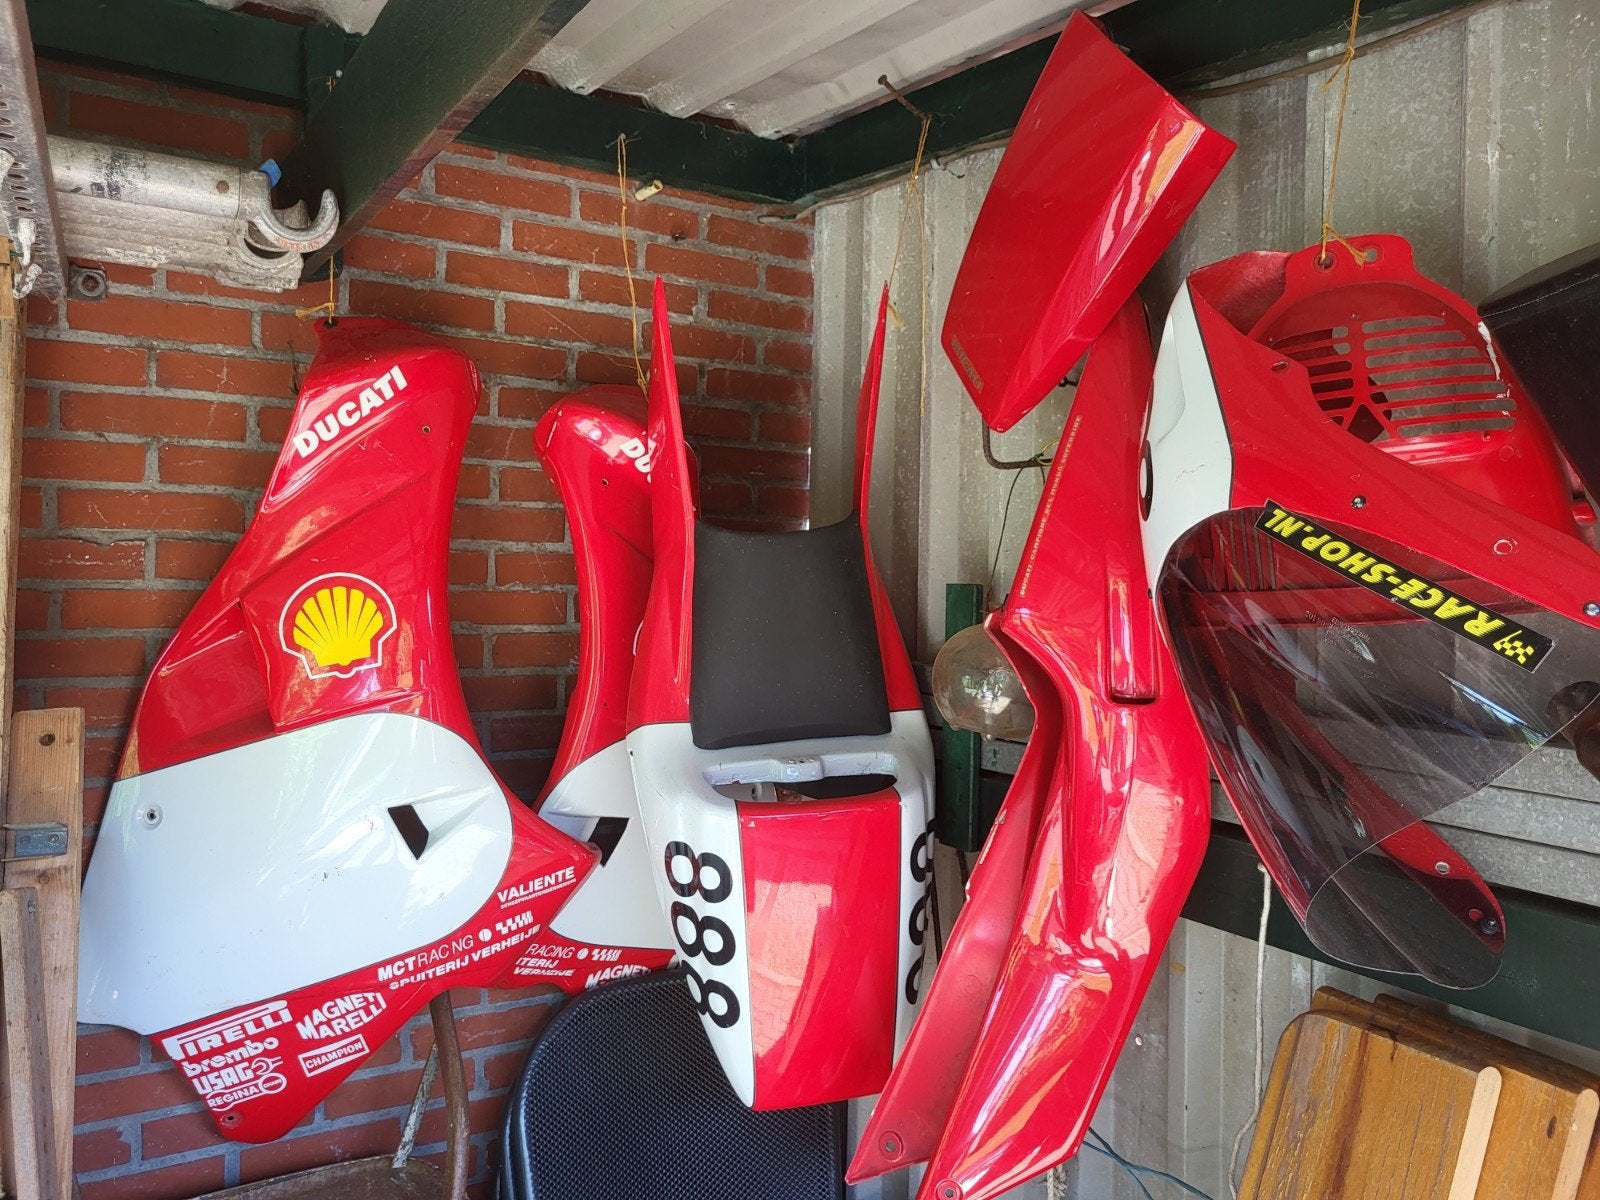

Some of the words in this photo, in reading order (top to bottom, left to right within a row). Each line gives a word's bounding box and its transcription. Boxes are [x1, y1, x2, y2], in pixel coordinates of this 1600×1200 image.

[292, 365, 408, 459] DUCATI
[620, 437, 652, 483] DU
[1020, 564, 1033, 597] DUCATI
[1030, 518, 1047, 560] CAMPIONE
[1264, 508, 1506, 638] RACE-SHOP.NL
[497, 866, 575, 903] VALIENTE
[389, 954, 470, 990] SPUITERIJ
[470, 923, 542, 962] VERHEIJE
[664, 840, 741, 1029] 888
[162, 1000, 293, 1060] PIRELLI
[295, 992, 387, 1038] MAGNETI
[295, 1001, 387, 1040] MARELLI
[181, 1037, 279, 1077] brembo
[192, 1062, 255, 1094] USAG
[305, 1041, 363, 1069] CHAMPION
[207, 1085, 260, 1108] REGINA
